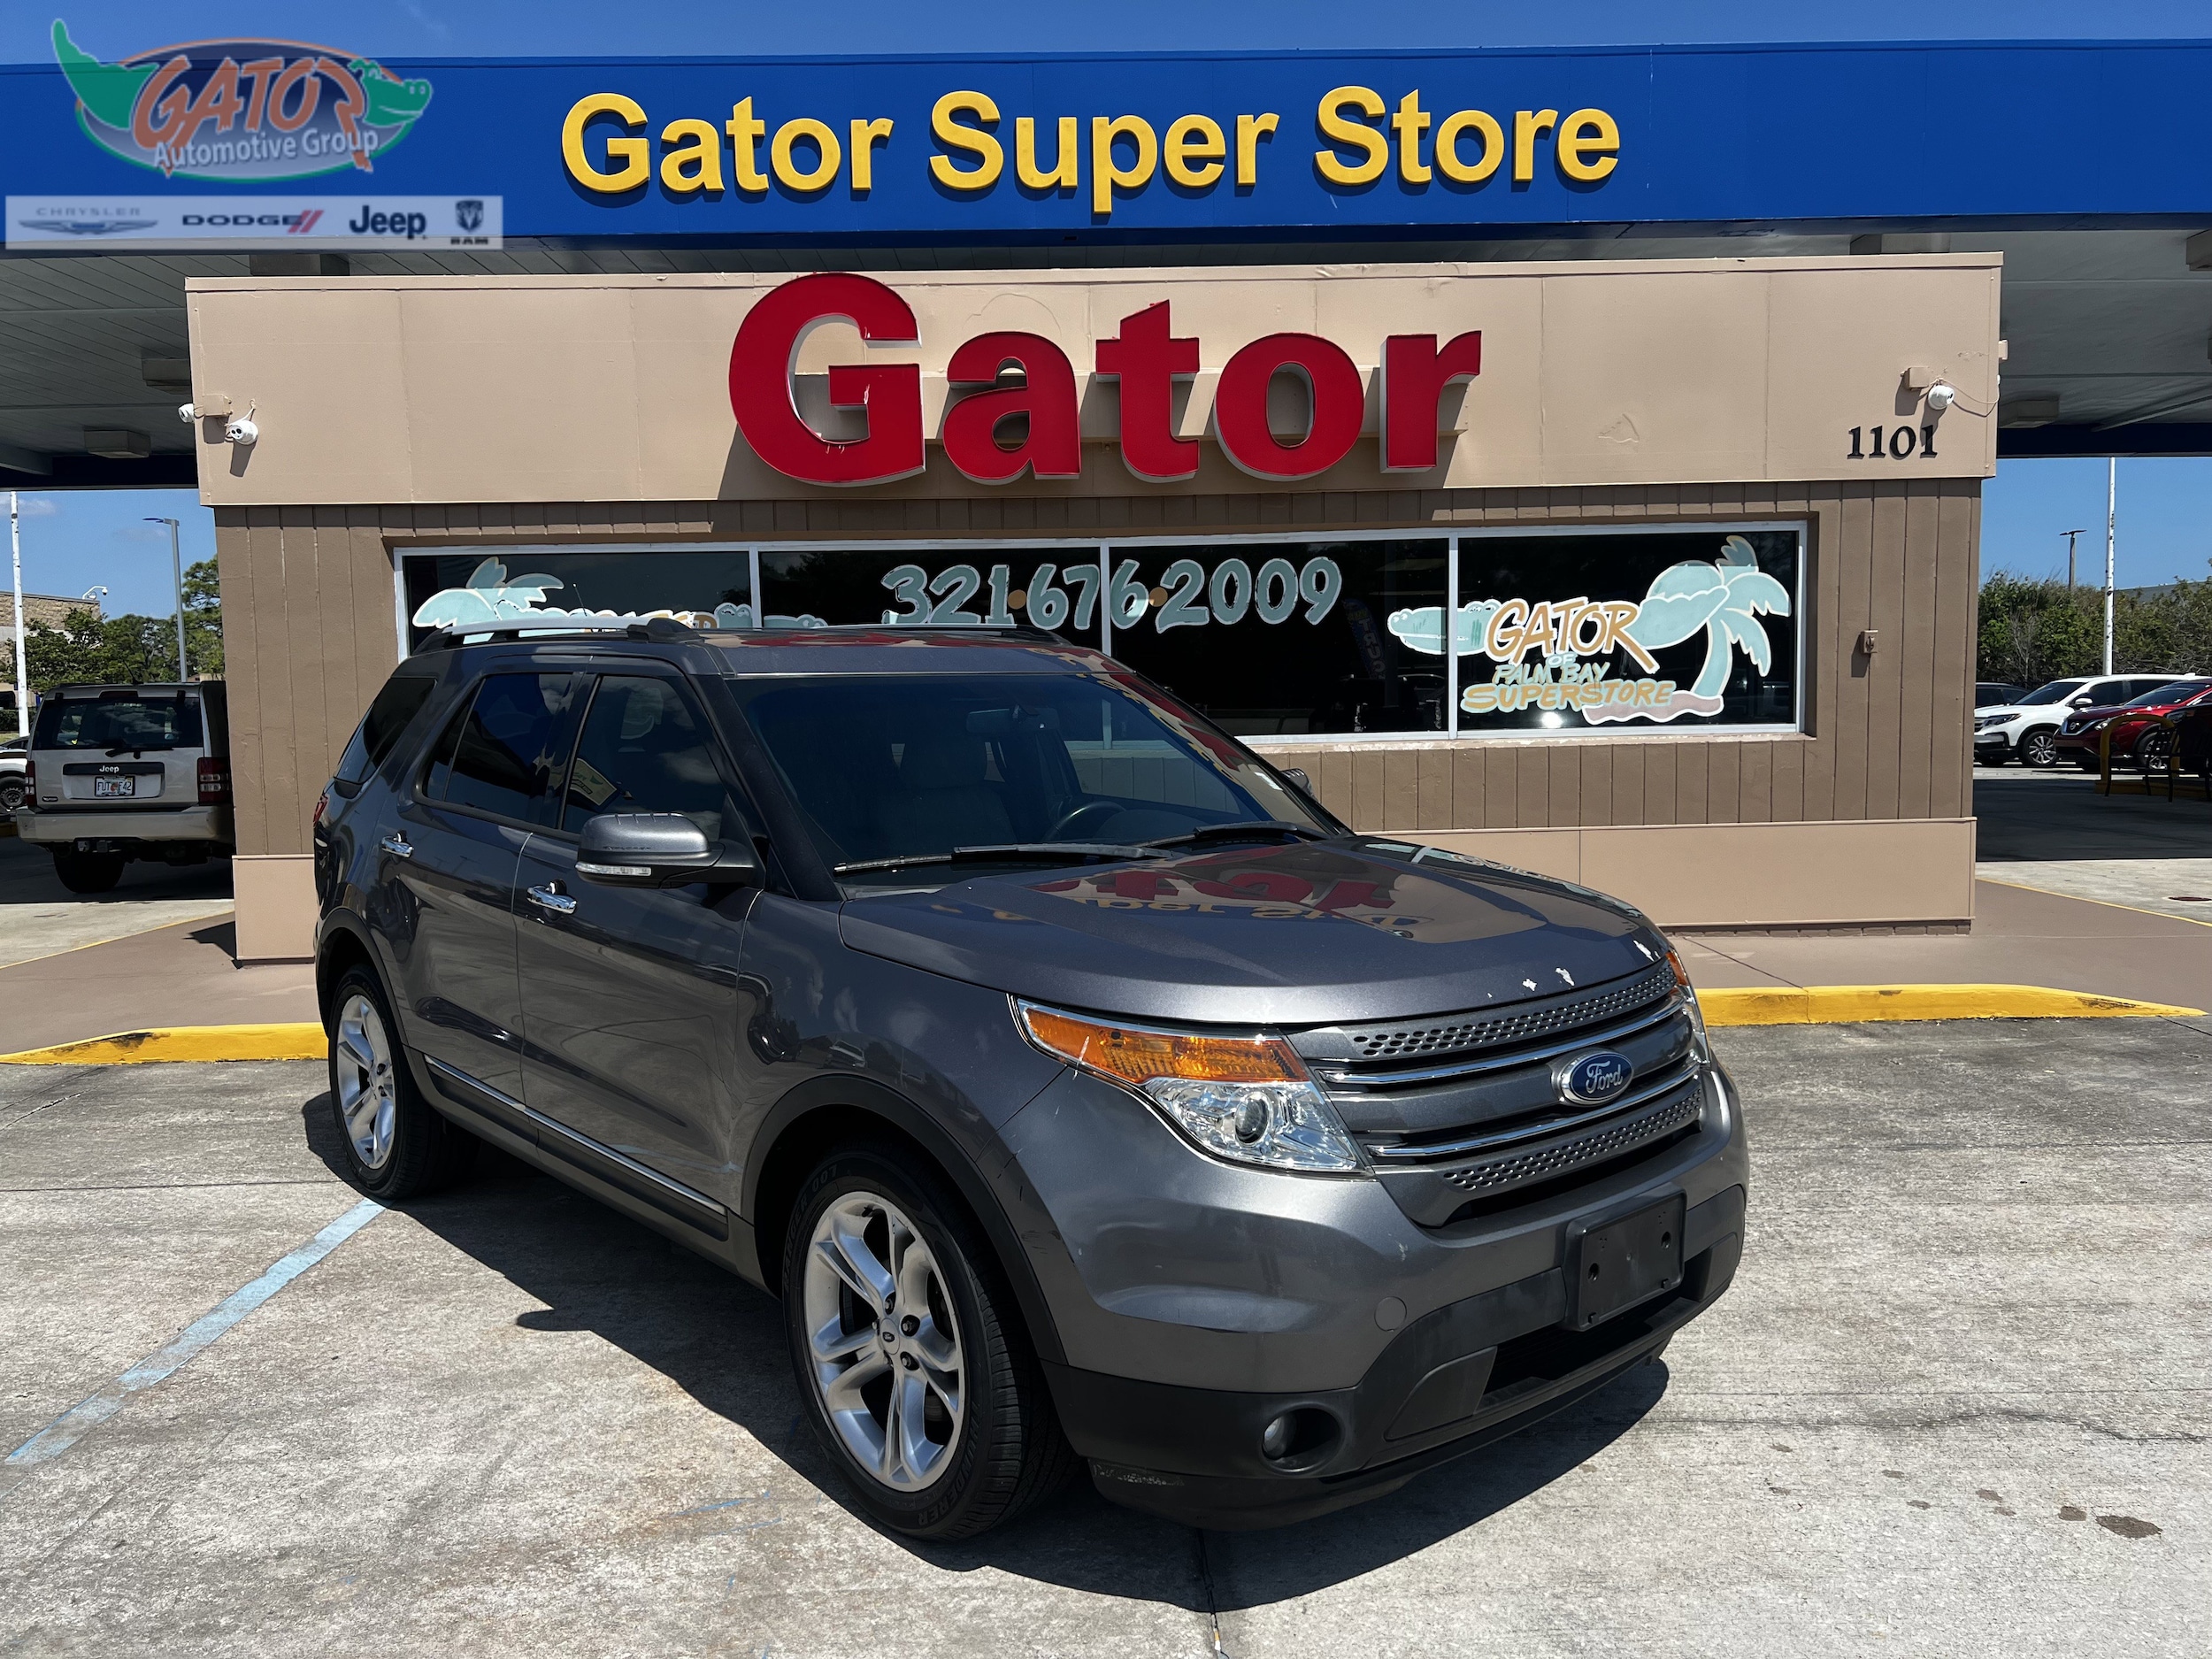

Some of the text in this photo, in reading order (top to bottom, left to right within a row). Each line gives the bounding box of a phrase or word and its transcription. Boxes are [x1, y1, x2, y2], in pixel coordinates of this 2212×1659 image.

[561, 85, 1621, 215] Gator Super Store
[728, 271, 1482, 488] Gator
[1847, 425, 1938, 460] 1101
[1485, 597, 1659, 673] GATOR
[1493, 662, 1610, 685] PALM BAY
[1548, 652, 1578, 668] OF
[1460, 678, 1677, 713] SUPERSTORE
[1585, 1060, 1624, 1094] Ford
